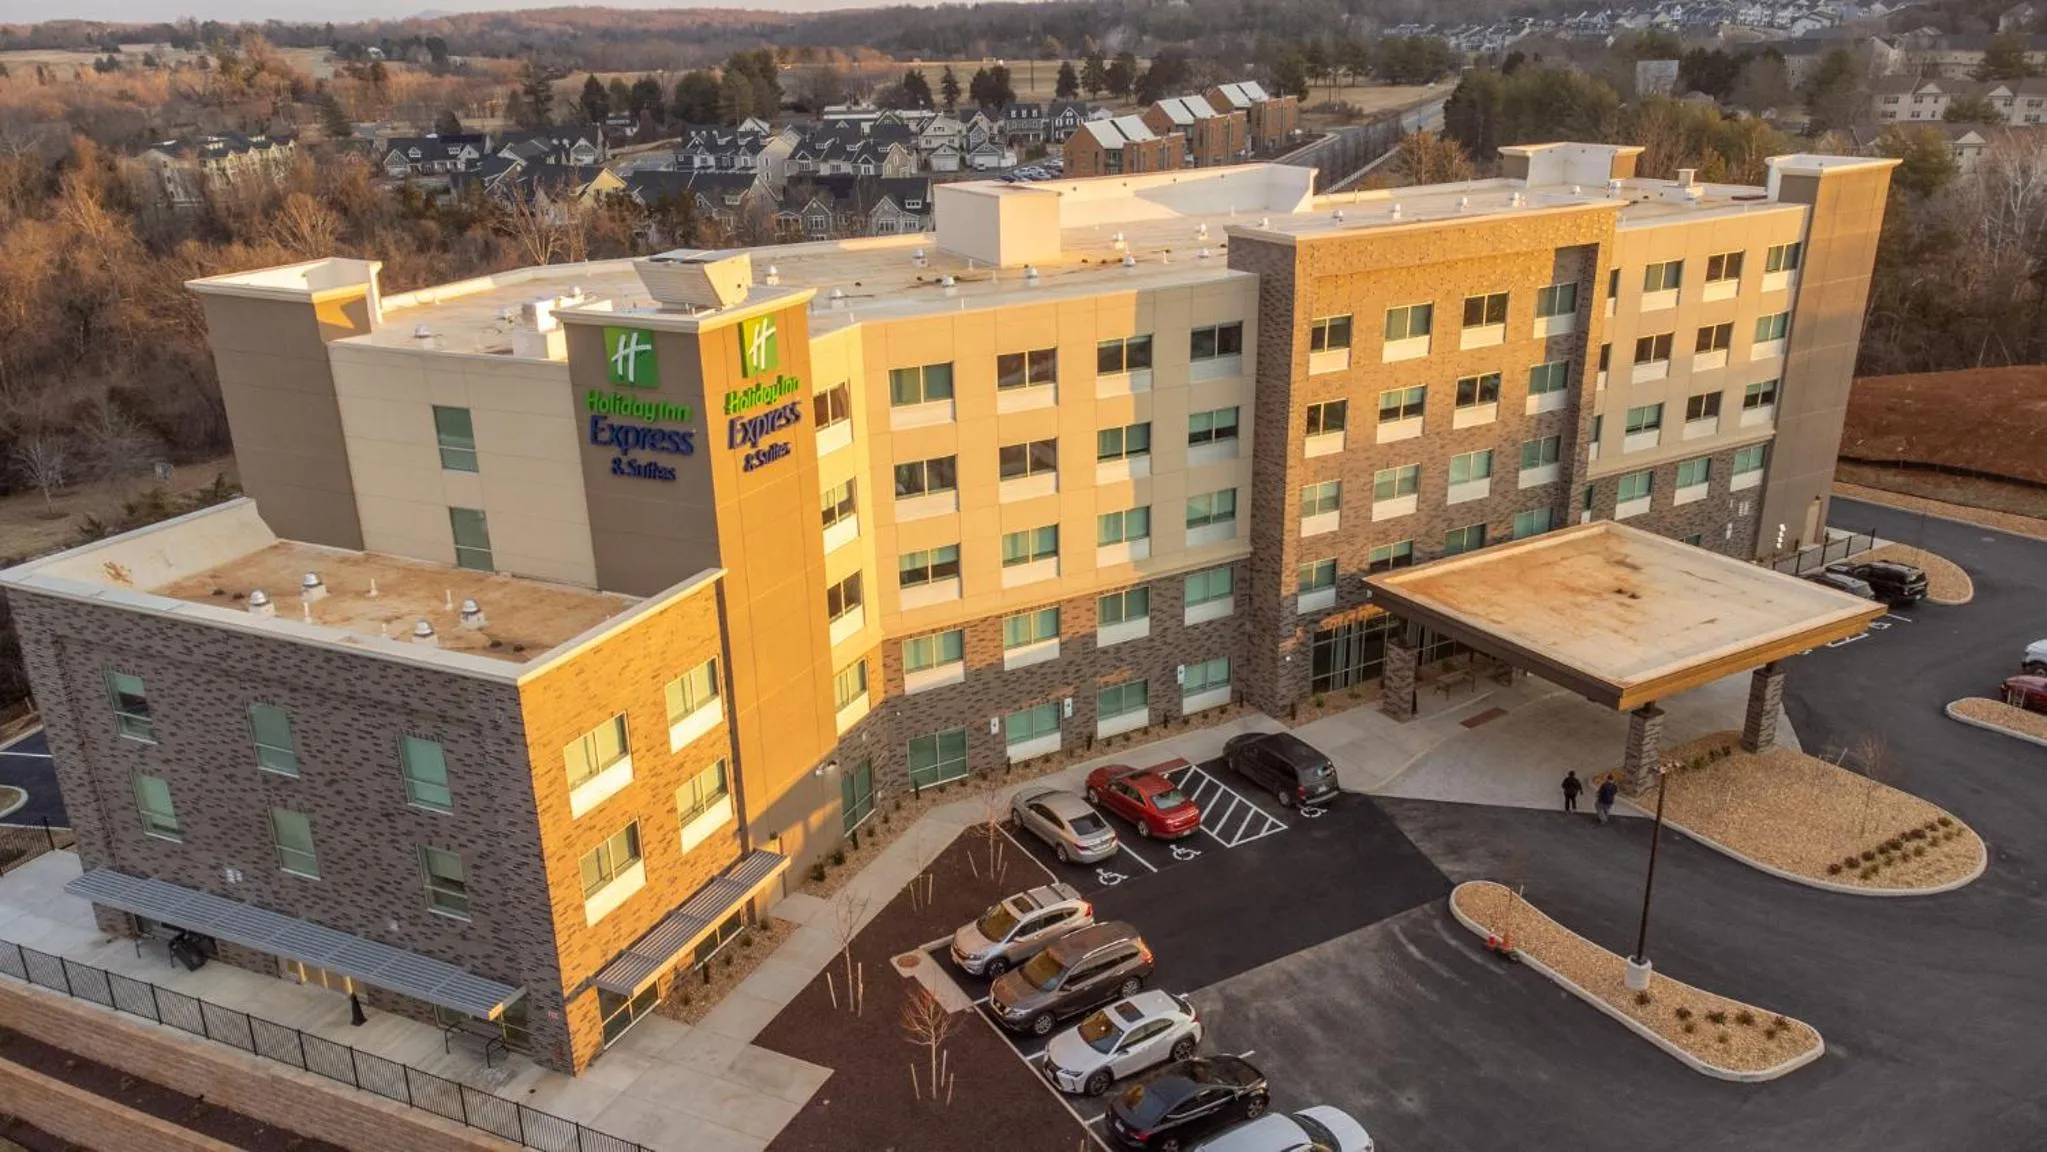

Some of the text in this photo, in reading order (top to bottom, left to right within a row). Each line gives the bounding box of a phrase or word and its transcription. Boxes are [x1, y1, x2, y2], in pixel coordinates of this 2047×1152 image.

[611, 332, 652, 381] H
[748, 318, 776, 369] H
[585, 390, 692, 423] Holiday Inn
[725, 375, 800, 414] Holiday Inn
[590, 415, 696, 456] Express
[728, 401, 802, 450] Express
[611, 457, 677, 481] & Suites
[743, 442, 792, 472] & Suites
